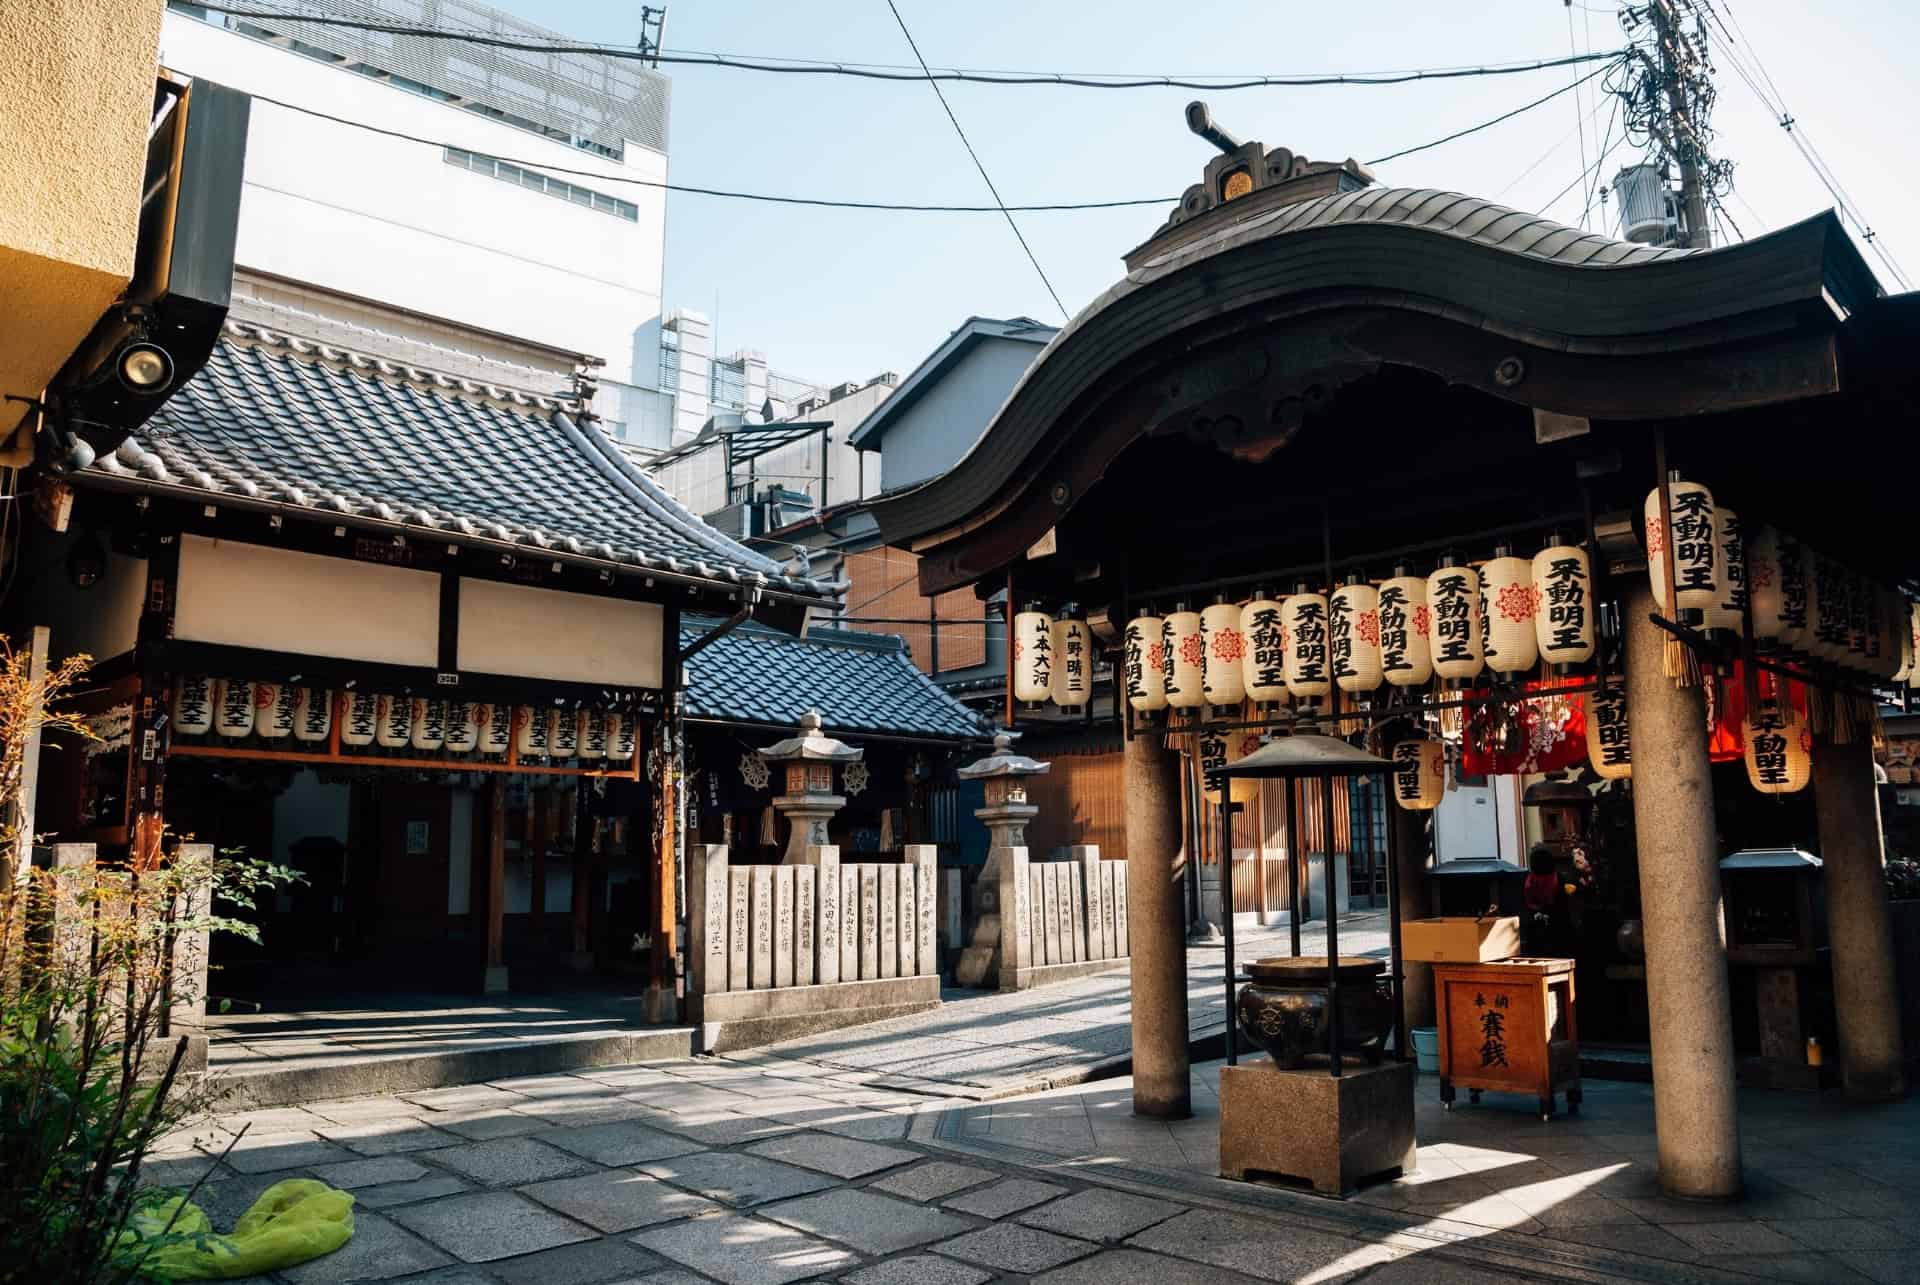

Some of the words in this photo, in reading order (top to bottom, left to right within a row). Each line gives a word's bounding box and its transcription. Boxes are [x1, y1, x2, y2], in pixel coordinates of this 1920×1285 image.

[1032, 618, 1051, 688] 山本大河
[1066, 625, 1083, 691] 山野晴三
